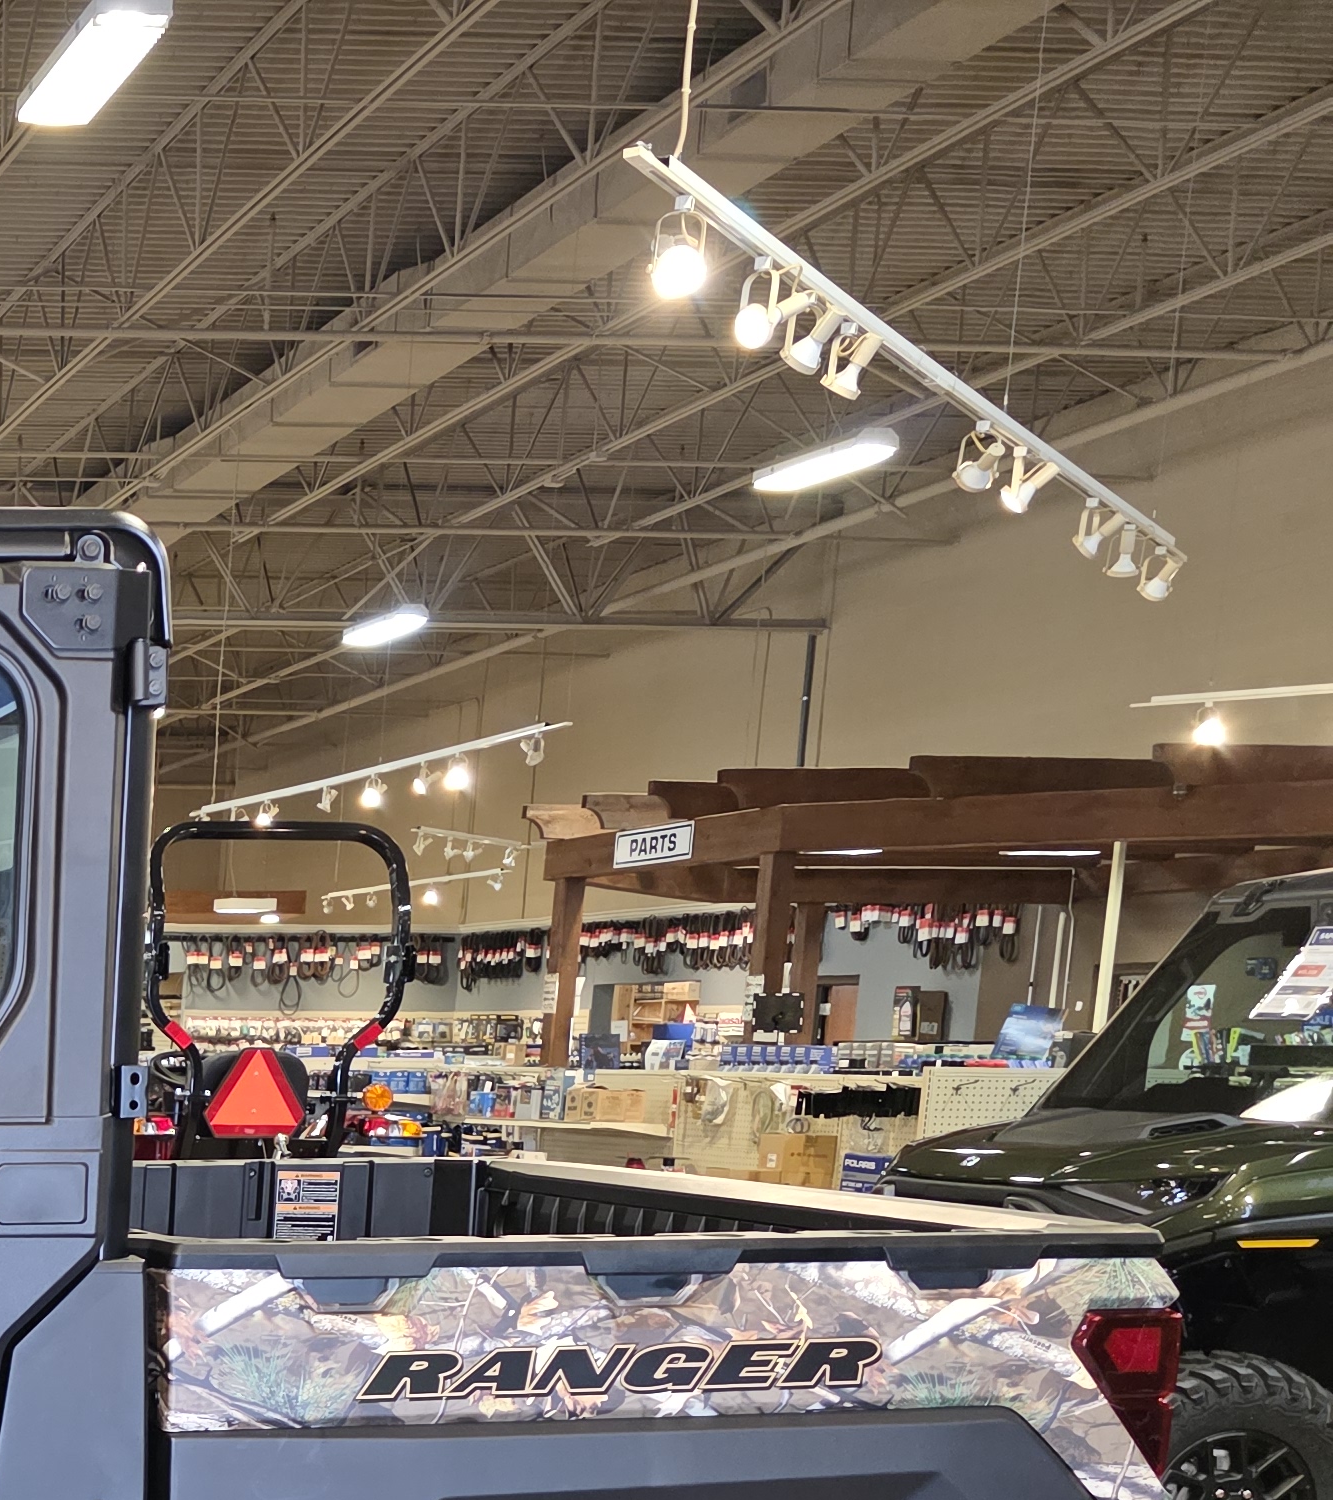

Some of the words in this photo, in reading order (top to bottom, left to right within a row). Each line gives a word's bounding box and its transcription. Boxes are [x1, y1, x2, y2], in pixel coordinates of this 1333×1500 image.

[630, 832, 677, 857] PARTS
[844, 1158, 876, 1170] POLARIS
[356, 1336, 882, 1404] RANGER
